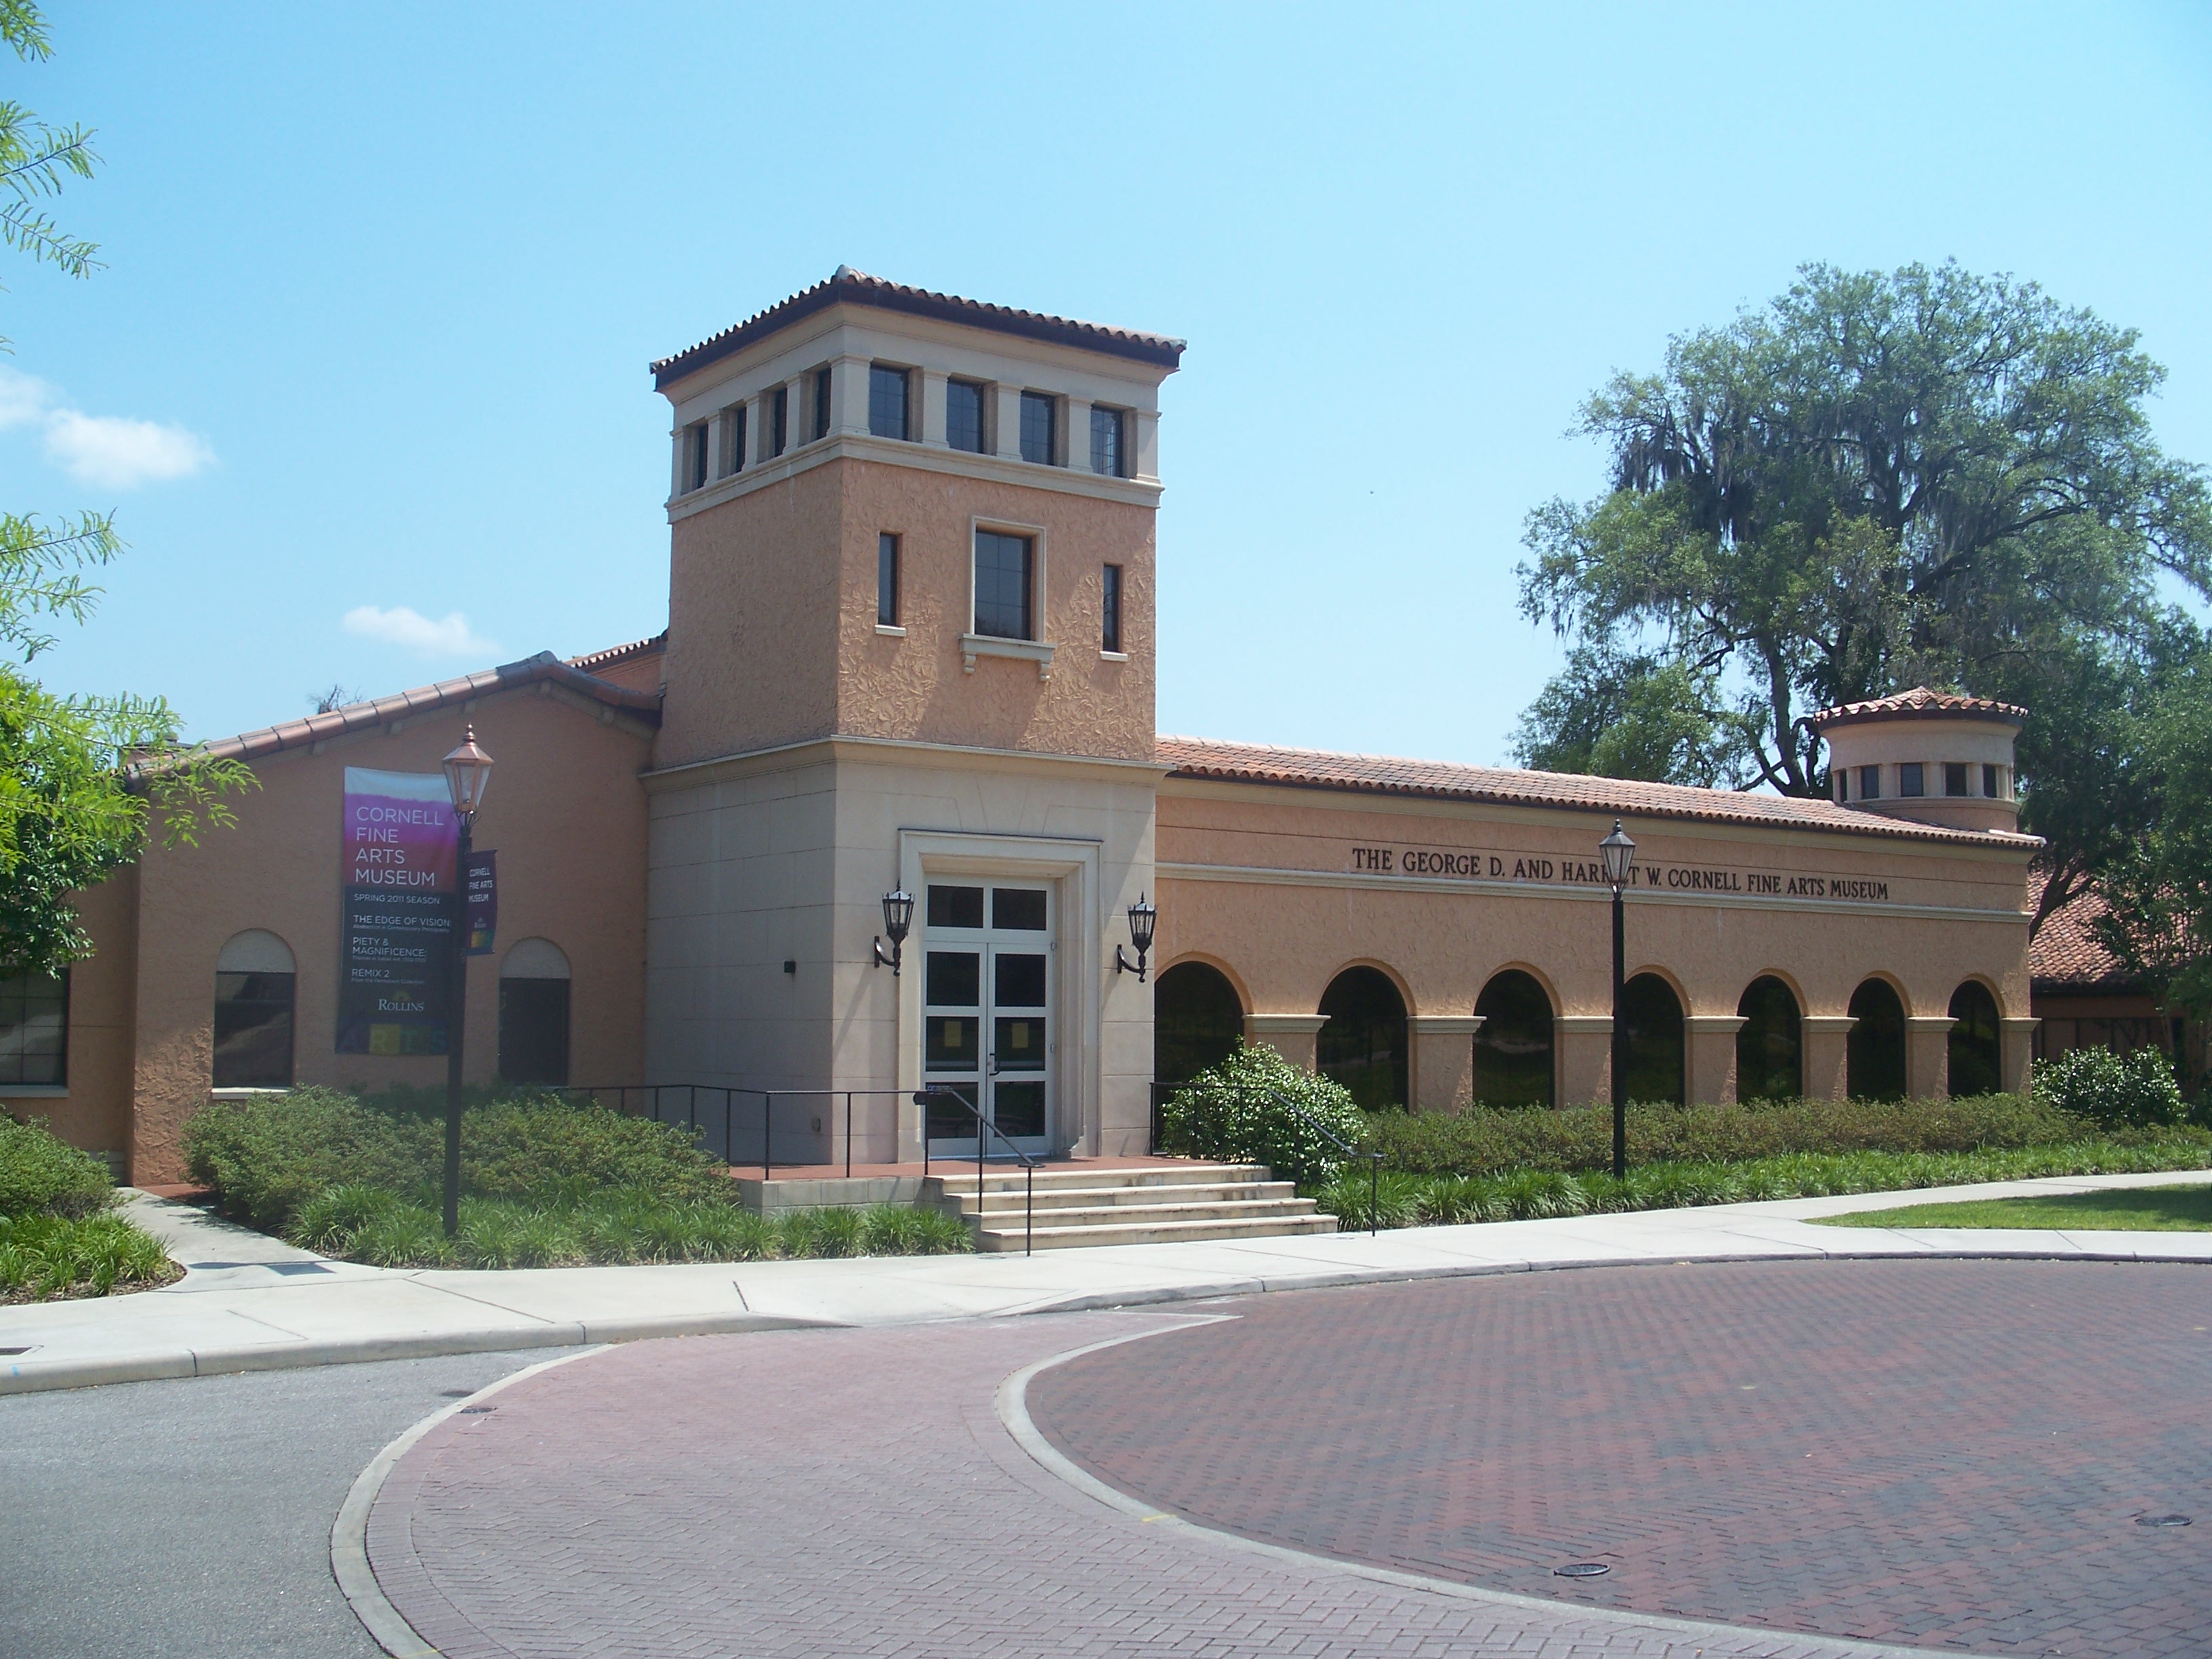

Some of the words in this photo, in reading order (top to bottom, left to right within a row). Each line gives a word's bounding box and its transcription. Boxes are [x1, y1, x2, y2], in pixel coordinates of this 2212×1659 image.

[356, 806, 444, 825] CORNELL
[356, 827, 399, 843] FINE
[355, 847, 405, 864] ARTS
[355, 868, 435, 886] MUSEUM
[469, 867, 491, 877] CORNELL
[1352, 848, 1392, 870] THE
[1402, 851, 1480, 875] GEORGE
[1490, 857, 1505, 877] D.
[1513, 859, 1553, 880] AND
[1645, 867, 1662, 886] W.
[1668, 869, 1742, 891] CORNELL
[1747, 874, 1781, 893] FINE
[1787, 877, 1824, 896] ARTS
[1830, 880, 1889, 899] MUSEUM
[469, 882, 480, 890] FINE
[480, 880, 493, 888] ARTS
[353, 893, 386, 903] SPRING
[387, 895, 405, 903] 2011
[407, 896, 441, 904] SEASON
[468, 894, 489, 902] MUSEUM
[353, 915, 372, 924] THE
[375, 916, 401, 925] EDGE
[404, 917, 417, 926] OF
[419, 918, 451, 927] VISION:
[352, 937, 380, 945] PIETY
[382, 938, 390, 946] &
[352, 947, 427, 957] MAGNIFICENCE:
[352, 968, 382, 977] REMIX
[384, 969, 390, 978] 2
